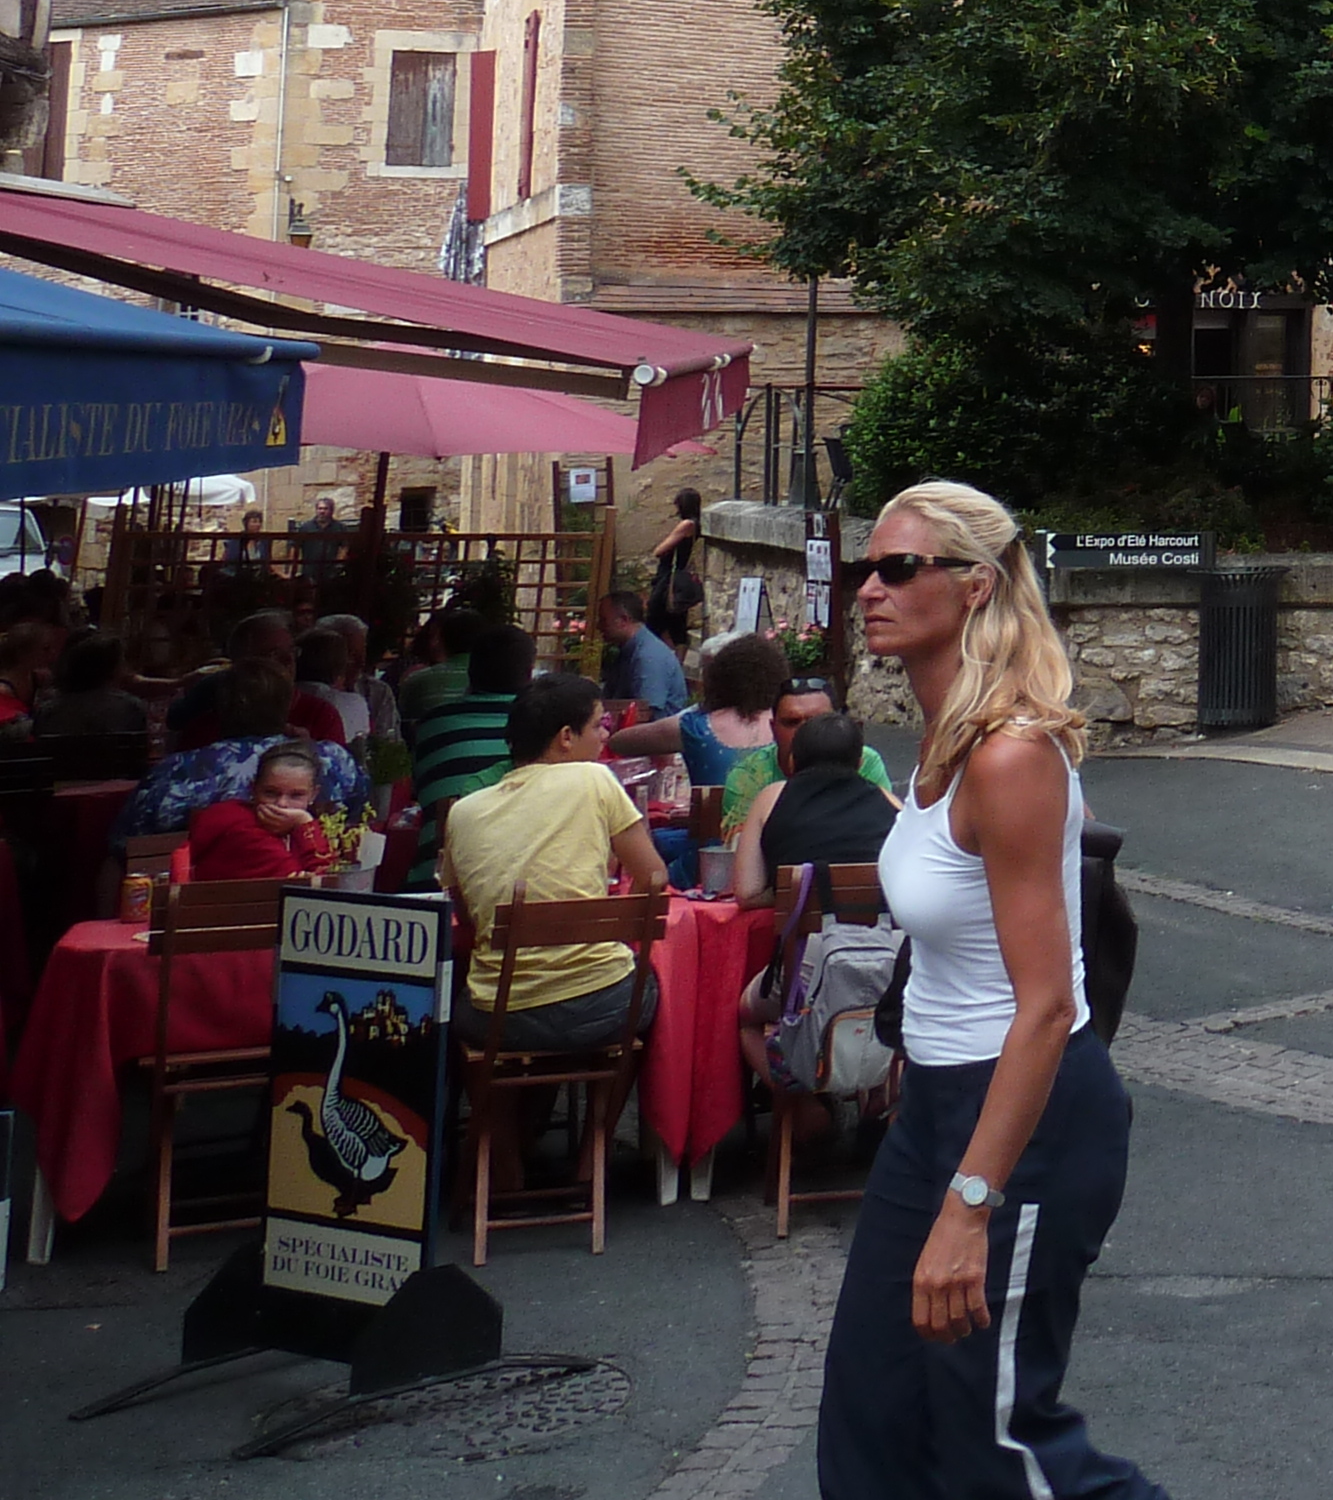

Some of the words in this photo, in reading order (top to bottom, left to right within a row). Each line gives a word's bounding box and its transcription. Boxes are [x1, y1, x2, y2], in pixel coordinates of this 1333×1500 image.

[0, 402, 119, 464] IALISTE
[122, 402, 162, 454] DU
[1076, 535, 1116, 549] L'Expo
[1149, 534, 1199, 547] Harcourt
[1109, 552, 1158, 566] Musée
[1161, 552, 1200, 565] Costi
[289, 908, 429, 966] GODARD
[272, 1254, 299, 1273] DU
[303, 1260, 350, 1284] FOIE
[277, 1235, 410, 1273] SPÉCIALISTE
